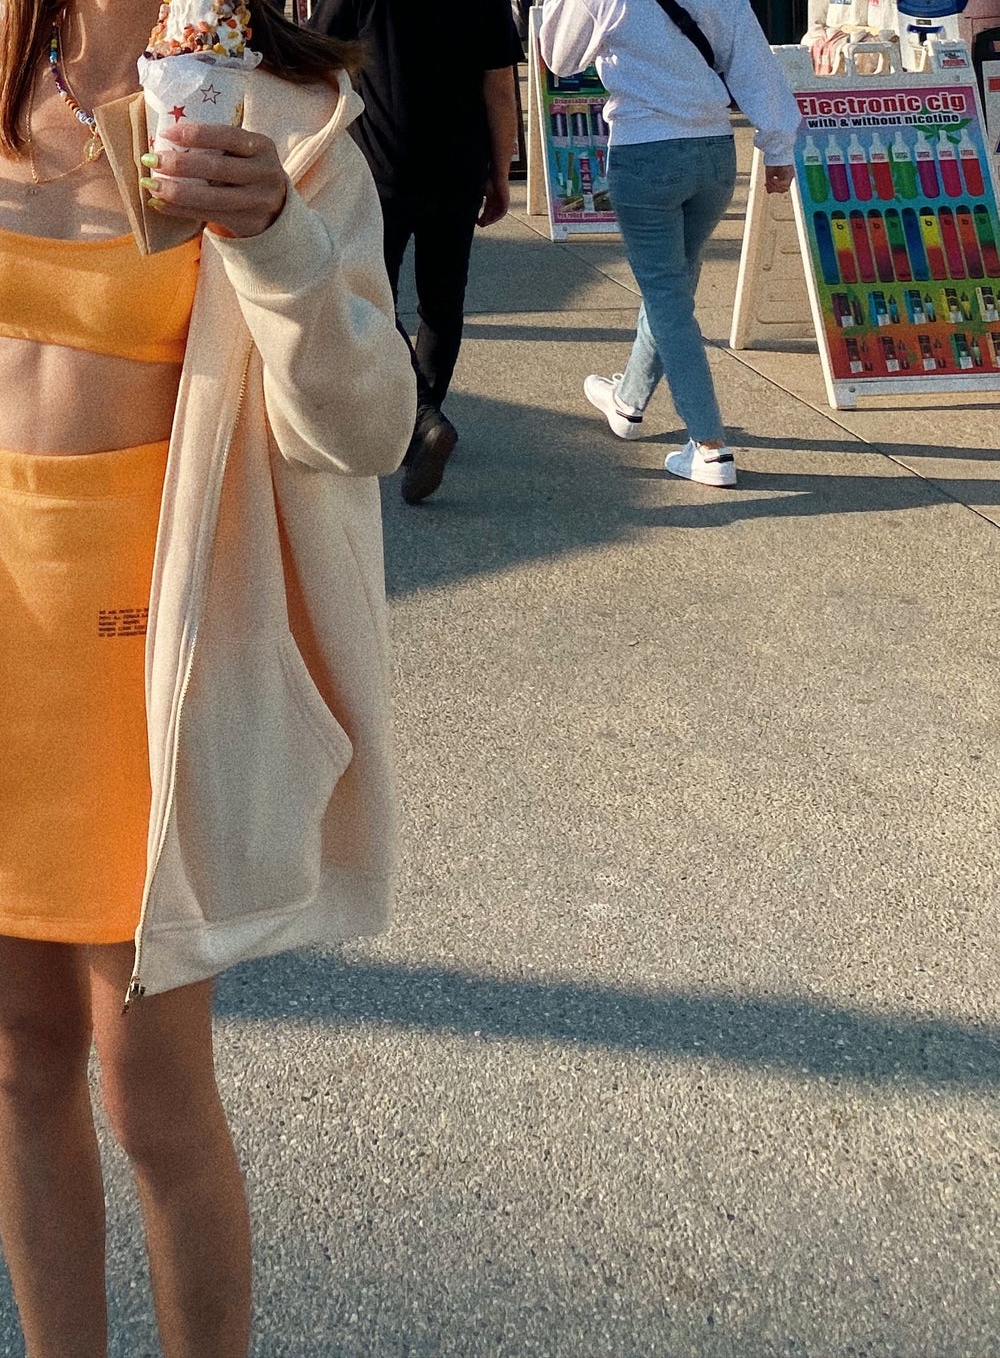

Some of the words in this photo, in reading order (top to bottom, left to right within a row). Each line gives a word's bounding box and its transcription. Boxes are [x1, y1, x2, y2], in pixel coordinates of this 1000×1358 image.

[797, 95, 921, 116] Electronic
[927, 93, 965, 112] cig
[808, 117, 837, 128] with
[841, 119, 848, 127] &
[852, 116, 901, 126] without
[905, 114, 959, 124] nicotine
